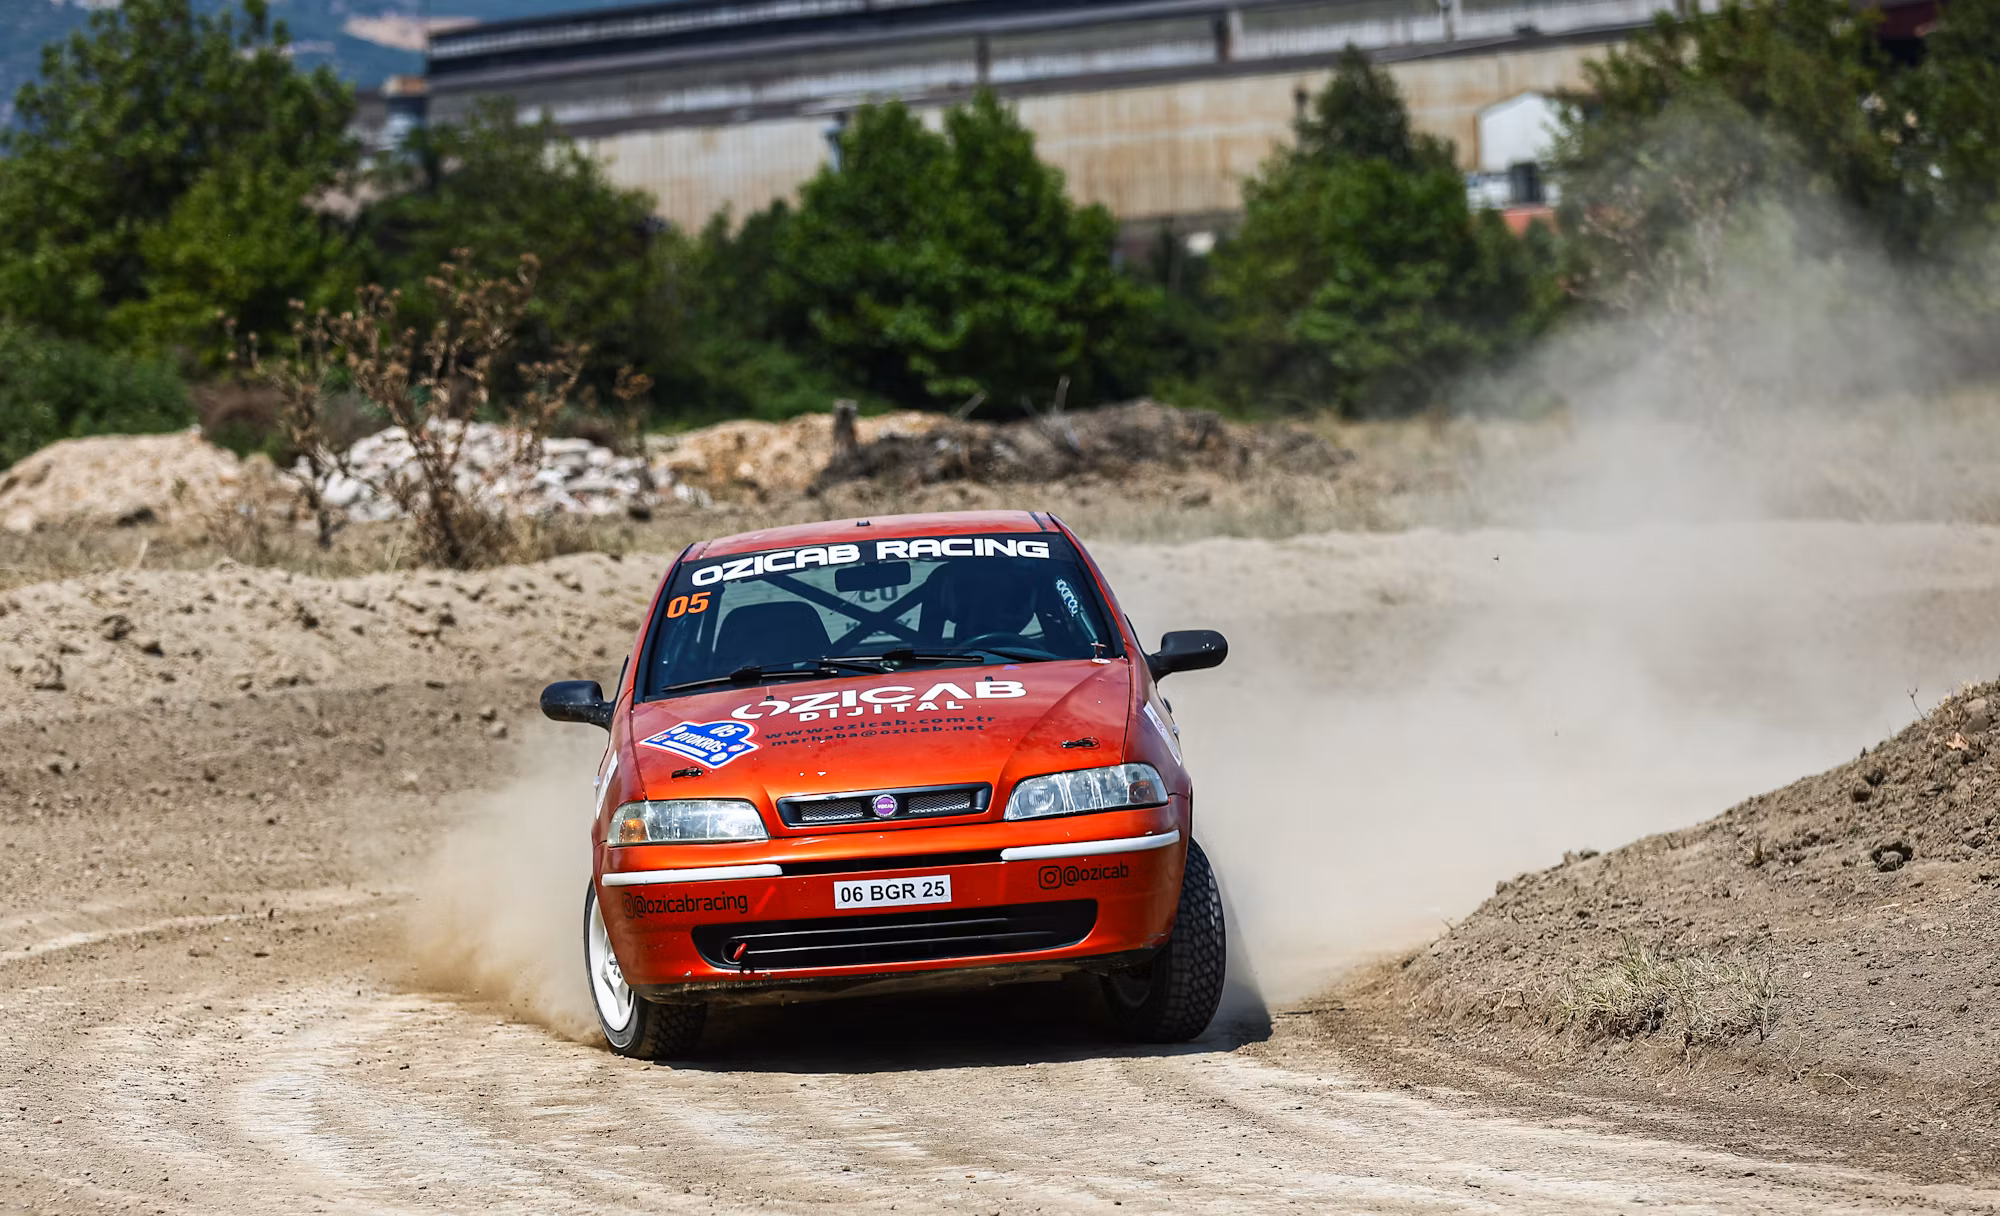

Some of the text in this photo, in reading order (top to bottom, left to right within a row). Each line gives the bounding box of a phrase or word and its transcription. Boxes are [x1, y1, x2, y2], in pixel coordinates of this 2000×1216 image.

[691, 538, 1050, 587] OZICAB RACING
[666, 591, 711, 618] 05
[731, 680, 1027, 719] OZICAB
[709, 724, 744, 737] 05
[764, 715, 996, 740] www.ozicab.com.tr
[771, 724, 985, 746] merhaba@ozicab.net
[673, 732, 728, 753] OTOKROS
[1063, 860, 1129, 886] @ozicab
[634, 890, 749, 918] @ozicabracing
[841, 880, 945, 903] 06 BGR 25
